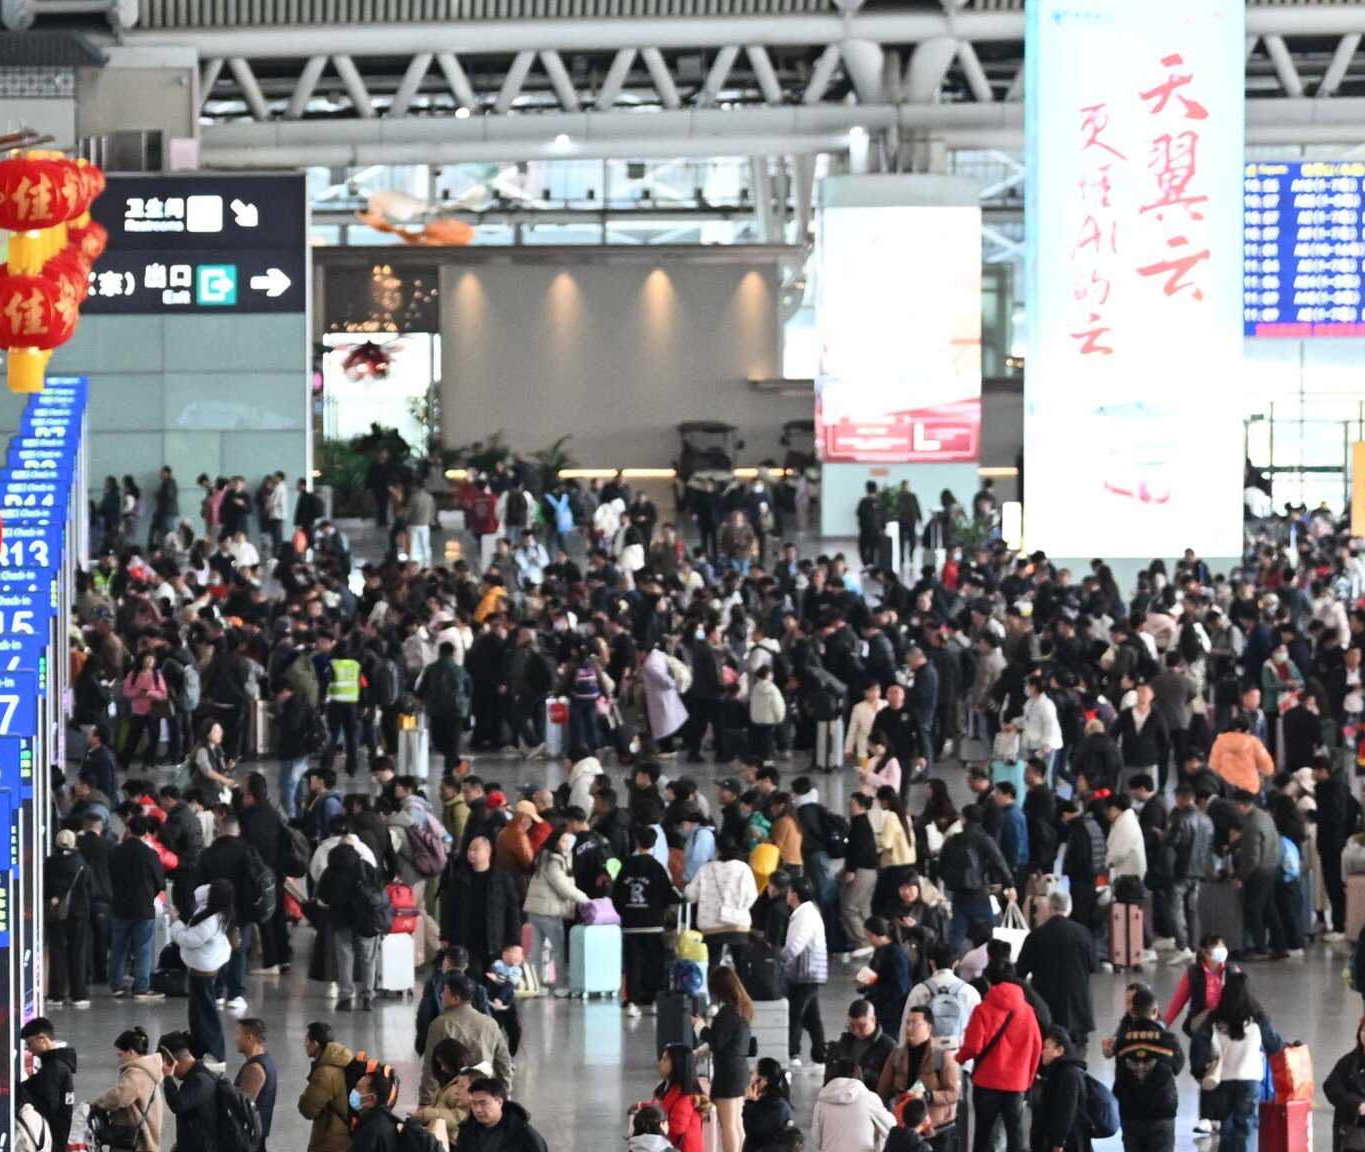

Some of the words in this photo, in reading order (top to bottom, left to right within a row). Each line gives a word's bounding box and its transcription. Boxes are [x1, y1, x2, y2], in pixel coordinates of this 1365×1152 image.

[11, 172, 53, 220] 佳
[1137, 53, 1211, 302] 天翼云
[144, 263, 191, 288] 出口
[5, 287, 48, 336] 佳
